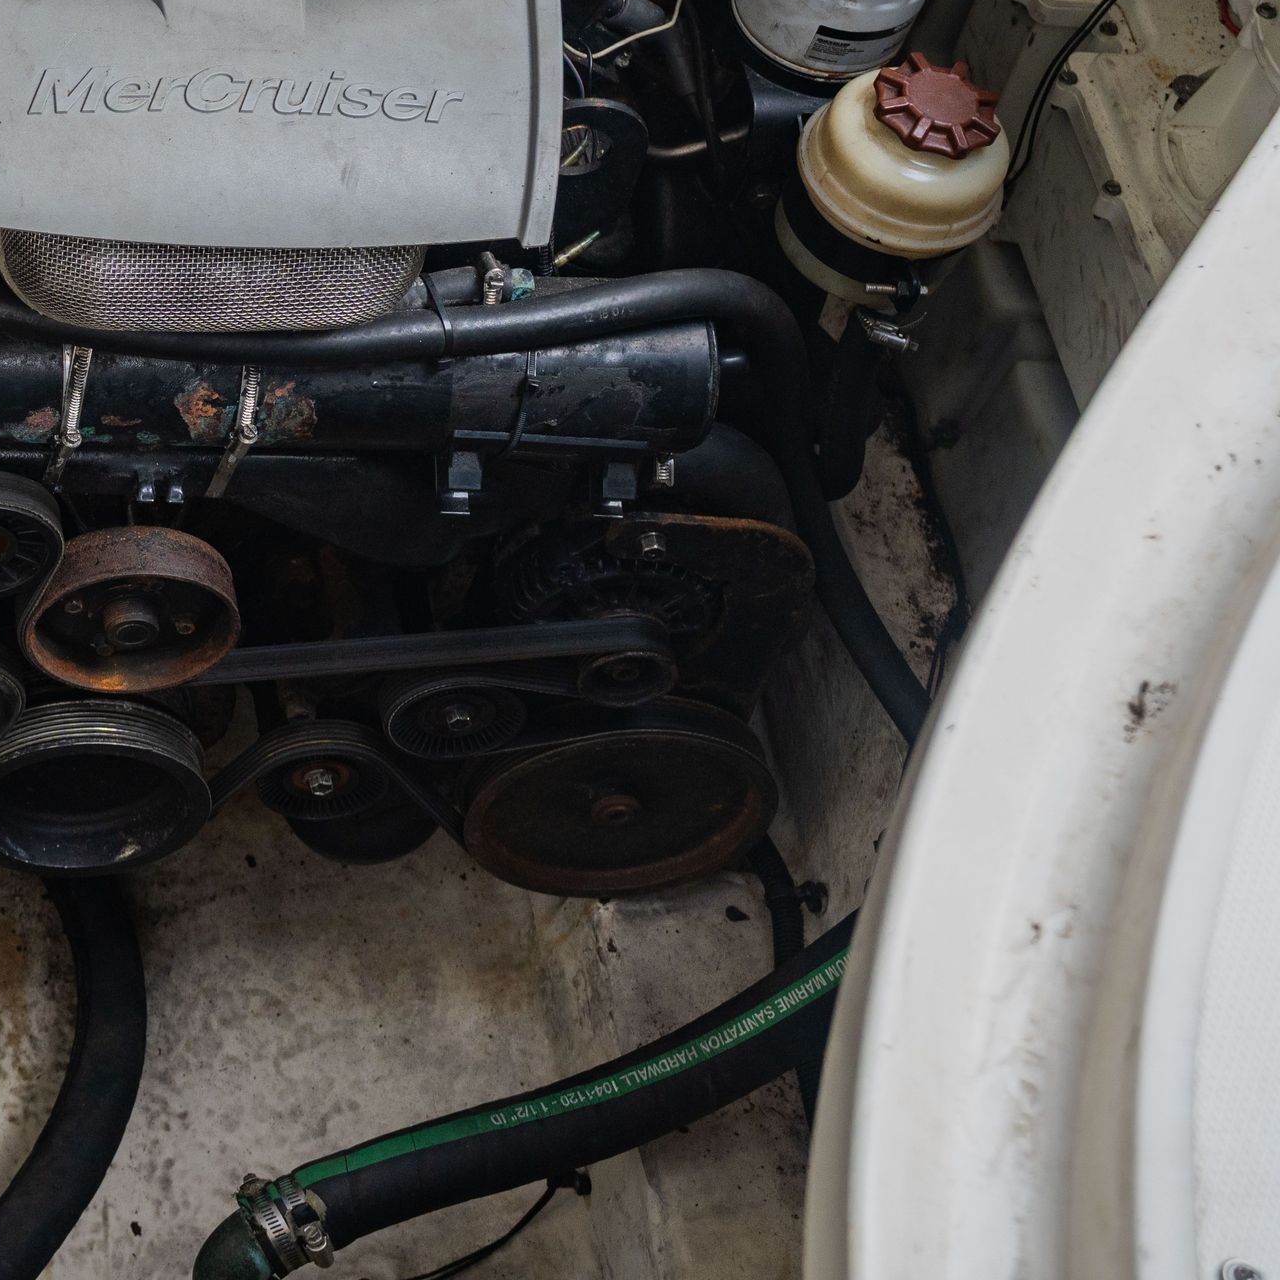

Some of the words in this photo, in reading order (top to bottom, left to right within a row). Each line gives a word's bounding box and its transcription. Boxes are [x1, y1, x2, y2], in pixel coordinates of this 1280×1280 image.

[26, 64, 465, 123] MerCruiser
[775, 973, 828, 1012] MARINE
[700, 1005, 776, 1055] SANITATION
[619, 1050, 698, 1087] HARDWALL
[559, 1081, 619, 1108] 104-1120
[490, 1112, 507, 1126] ID
